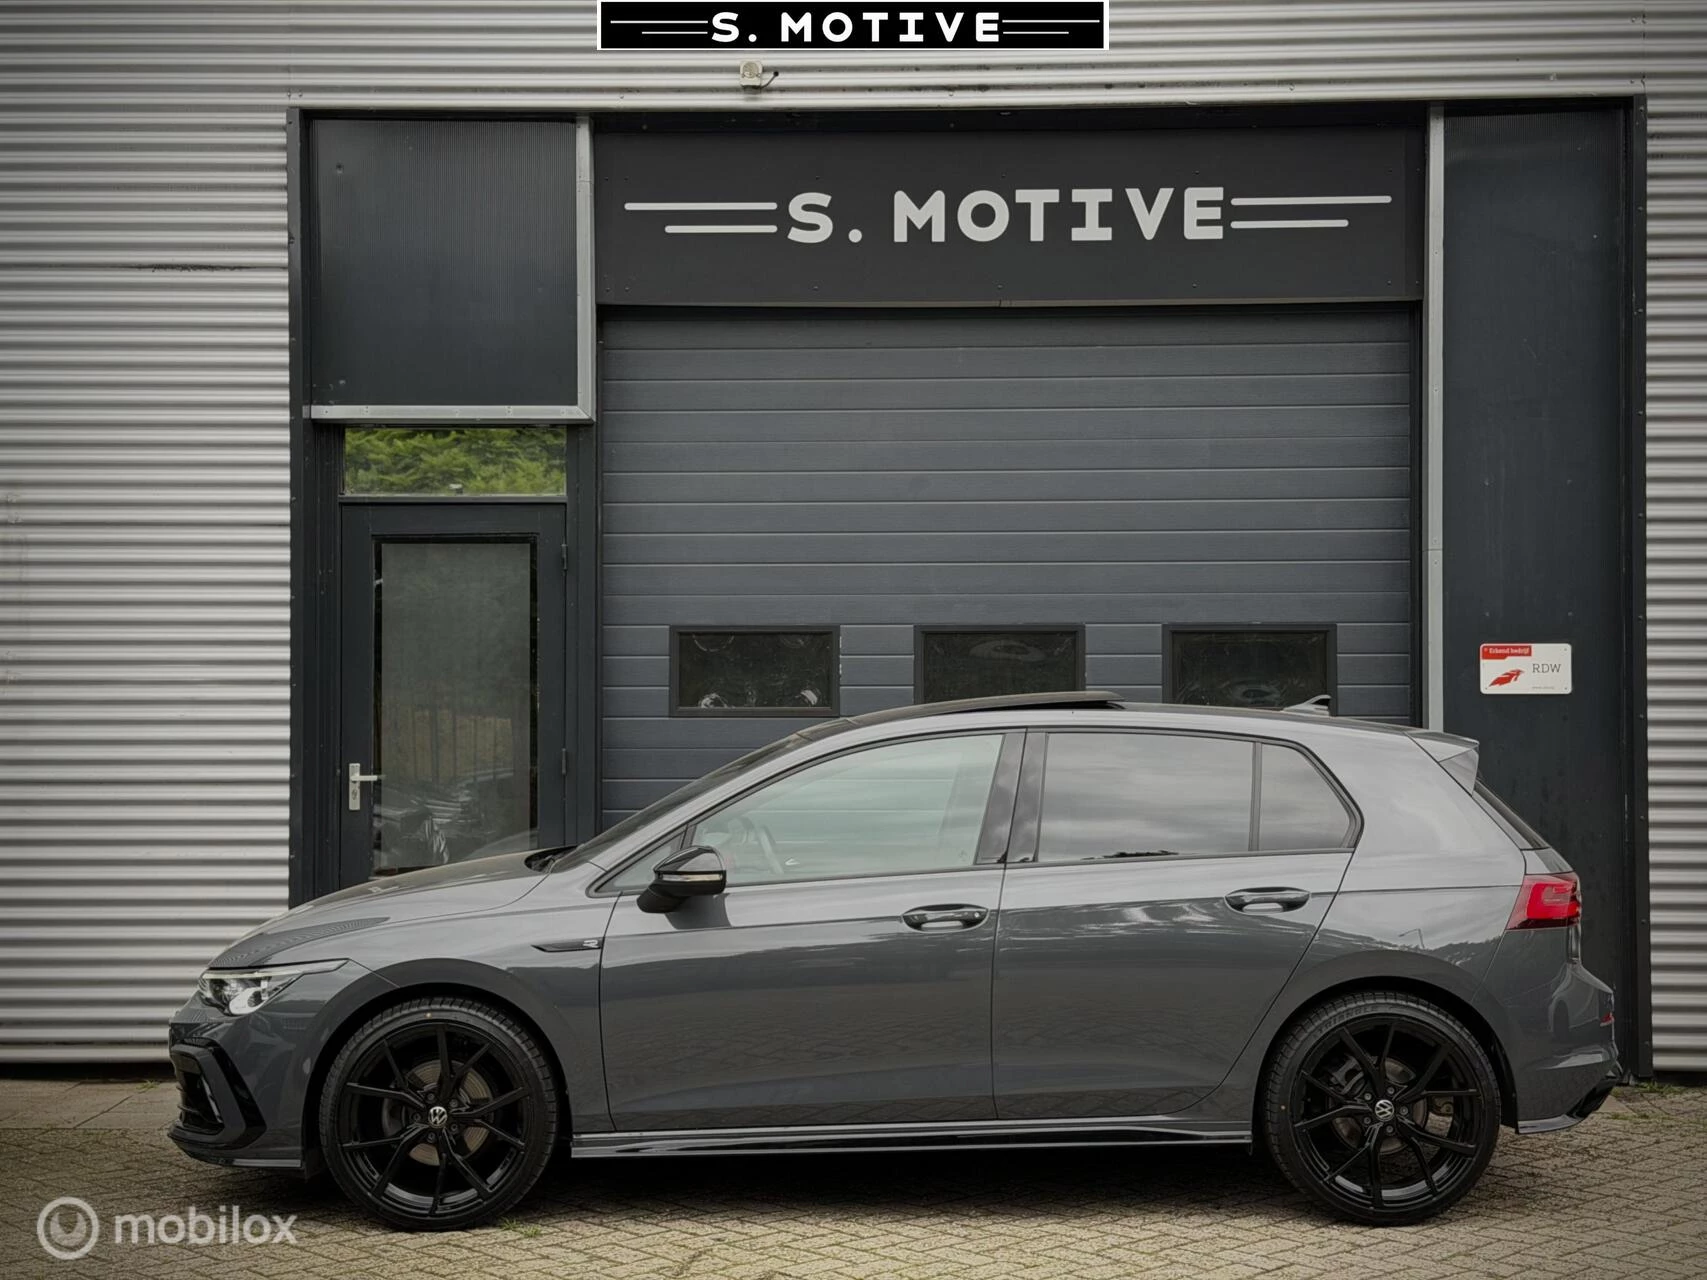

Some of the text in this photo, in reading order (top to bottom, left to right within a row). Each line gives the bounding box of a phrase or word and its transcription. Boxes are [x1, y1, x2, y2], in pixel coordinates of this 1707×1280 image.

[787, 187, 1224, 244] S. MOTIVE
[1532, 663, 1561, 673] RDW
